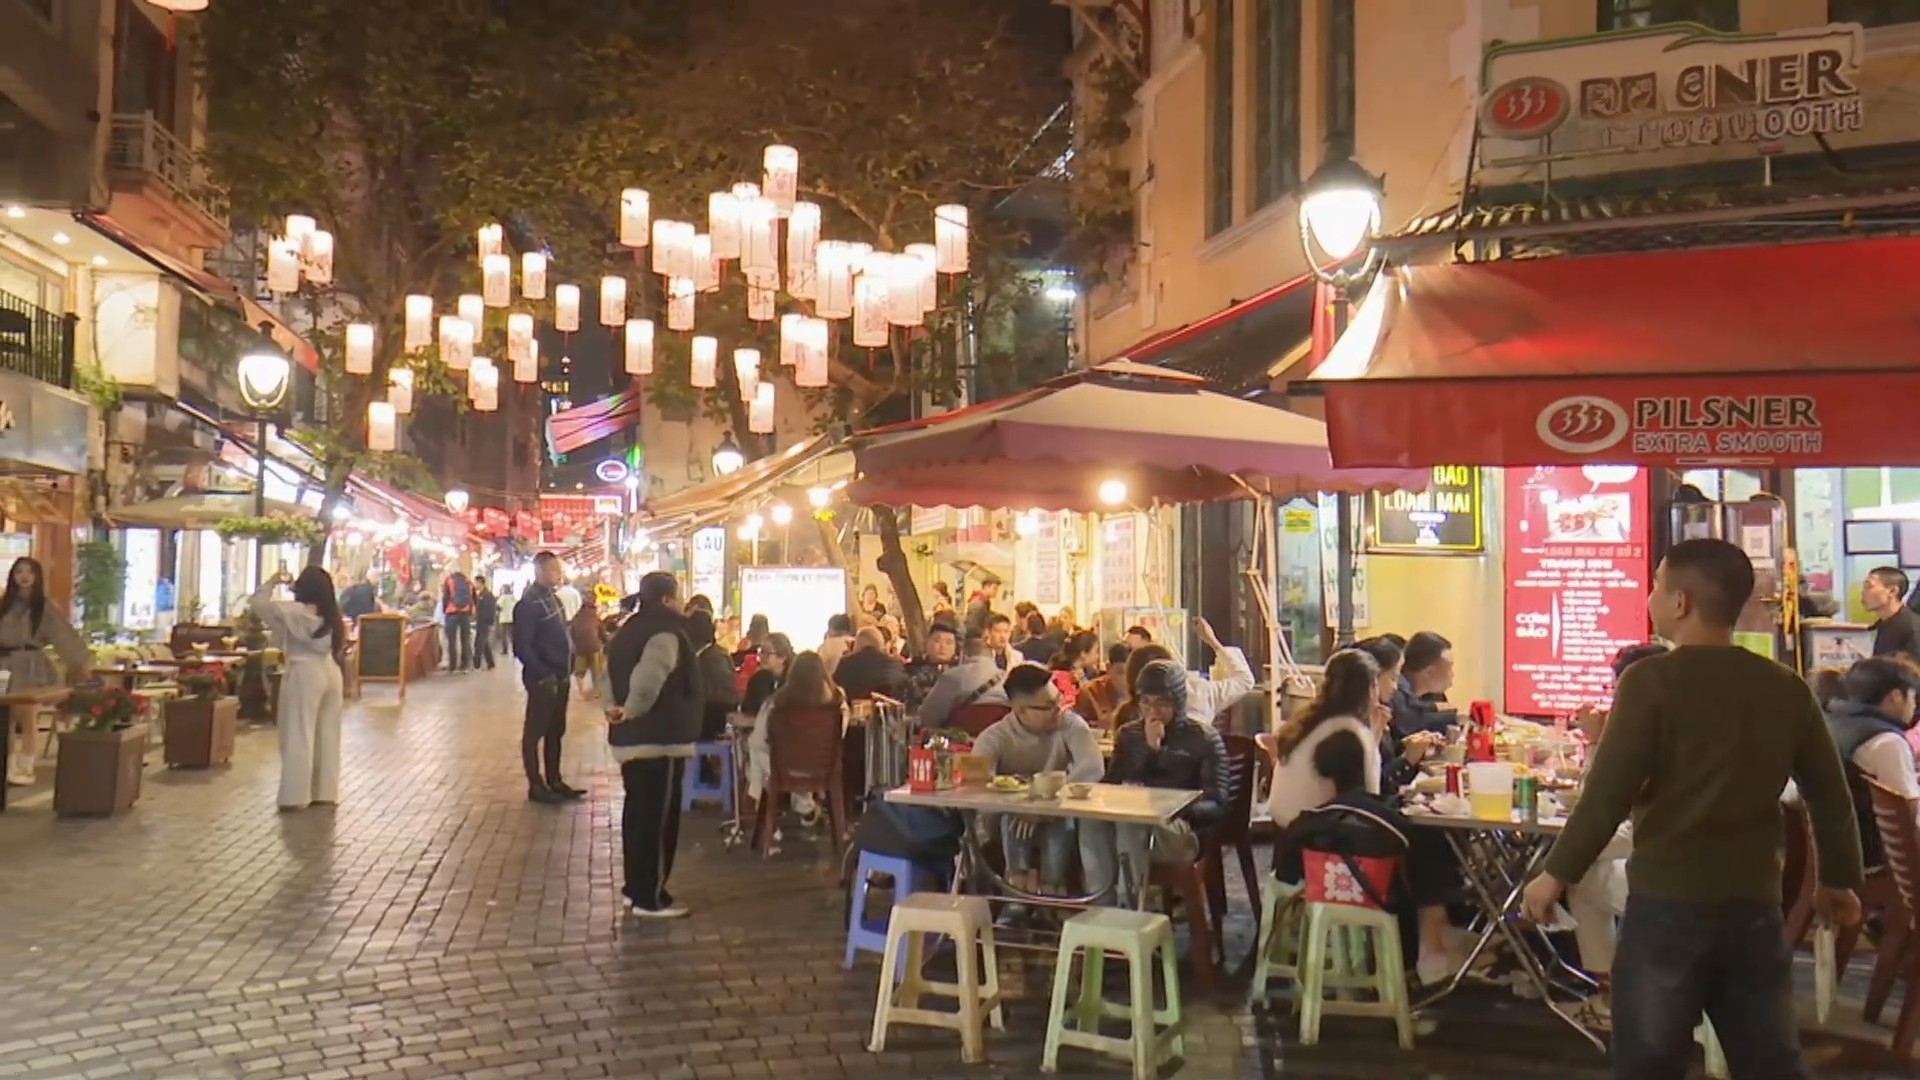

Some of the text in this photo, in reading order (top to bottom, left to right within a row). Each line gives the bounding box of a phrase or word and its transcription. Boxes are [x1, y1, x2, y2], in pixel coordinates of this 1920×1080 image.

[1632, 395, 1821, 428] PILSNER
[1632, 430, 1822, 454] EXTRA SMOOTH
[1384, 489, 1431, 512] LOAN
[1436, 491, 1471, 513] MAI
